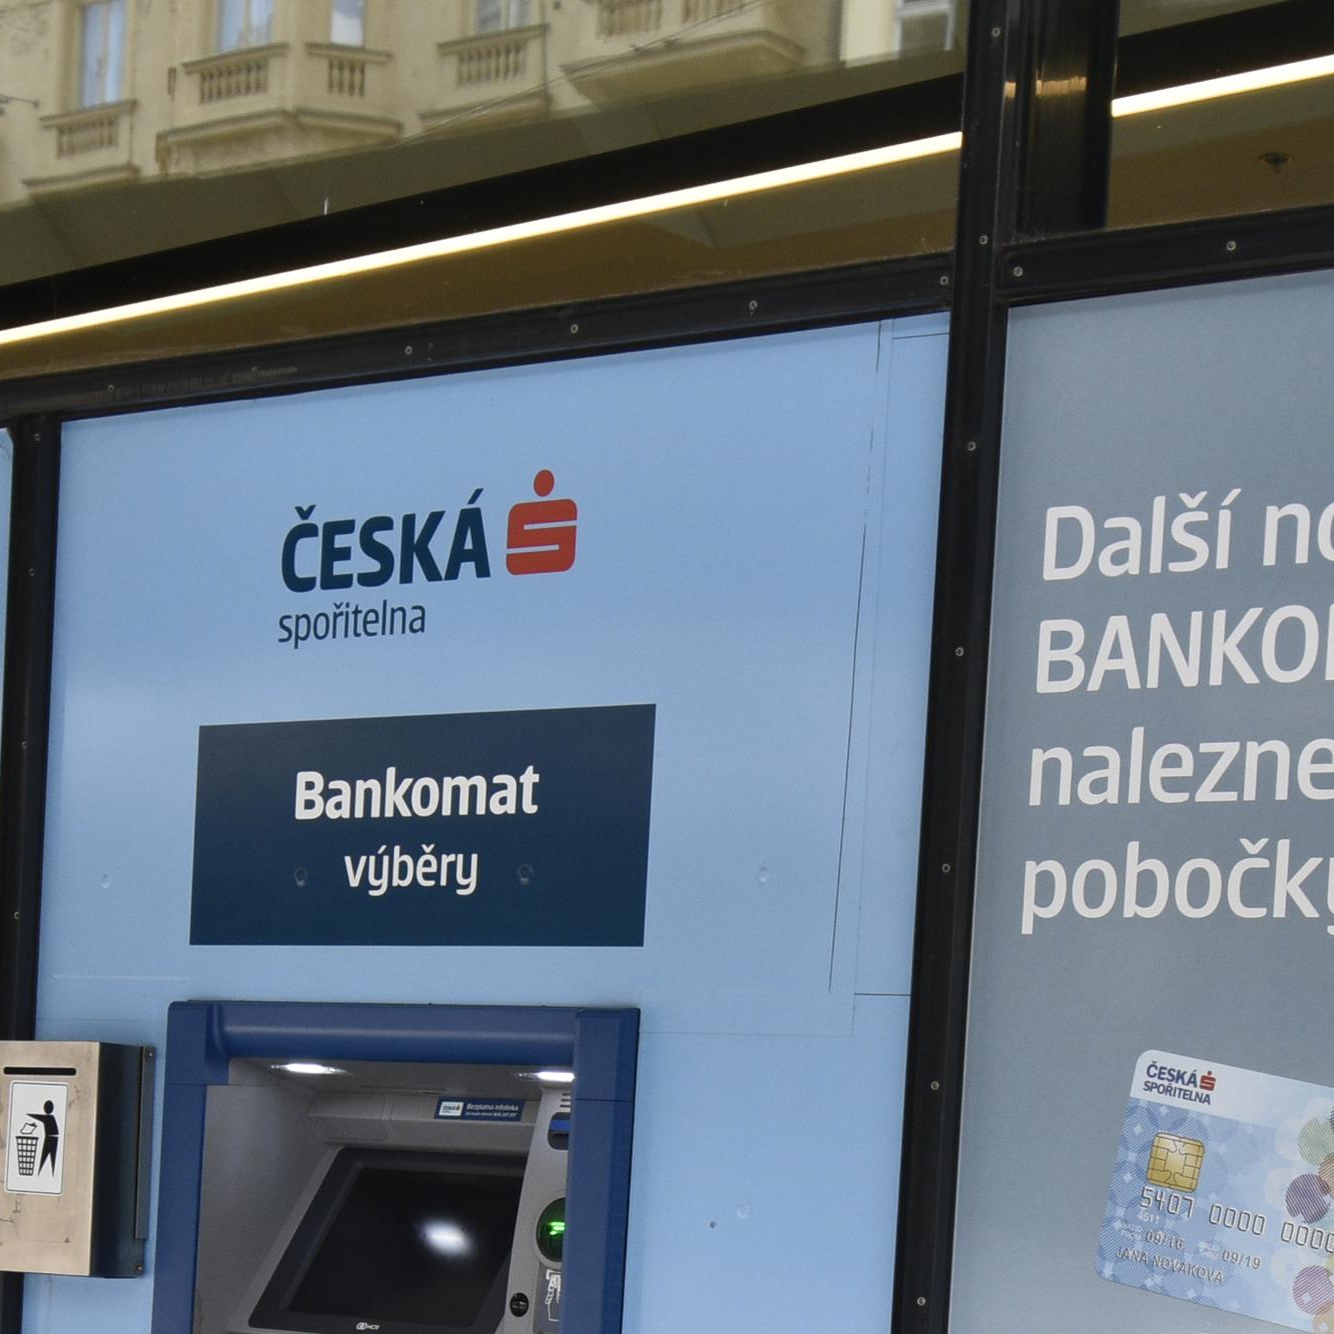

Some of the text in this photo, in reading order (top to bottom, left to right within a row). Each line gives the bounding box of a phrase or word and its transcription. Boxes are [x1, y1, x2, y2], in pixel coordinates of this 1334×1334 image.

[280, 488, 492, 593] ČESKÁ
[1041, 488, 1242, 581] Další
[277, 599, 427, 650] spořitelna
[294, 764, 540, 820] Bankomat
[344, 843, 479, 896] výběry
[1142, 1079, 1212, 1106] SPOŘITELNA
[1145, 1060, 1199, 1089] ČESKÁ
[1139, 1185, 1196, 1219] 5407
[1208, 1202, 1267, 1236] 0000
[1116, 1246, 1225, 1284] JANA NOVAKOVA
[1145, 1229, 1185, 1250] 09/16
[1221, 1249, 1262, 1270] 09/19
